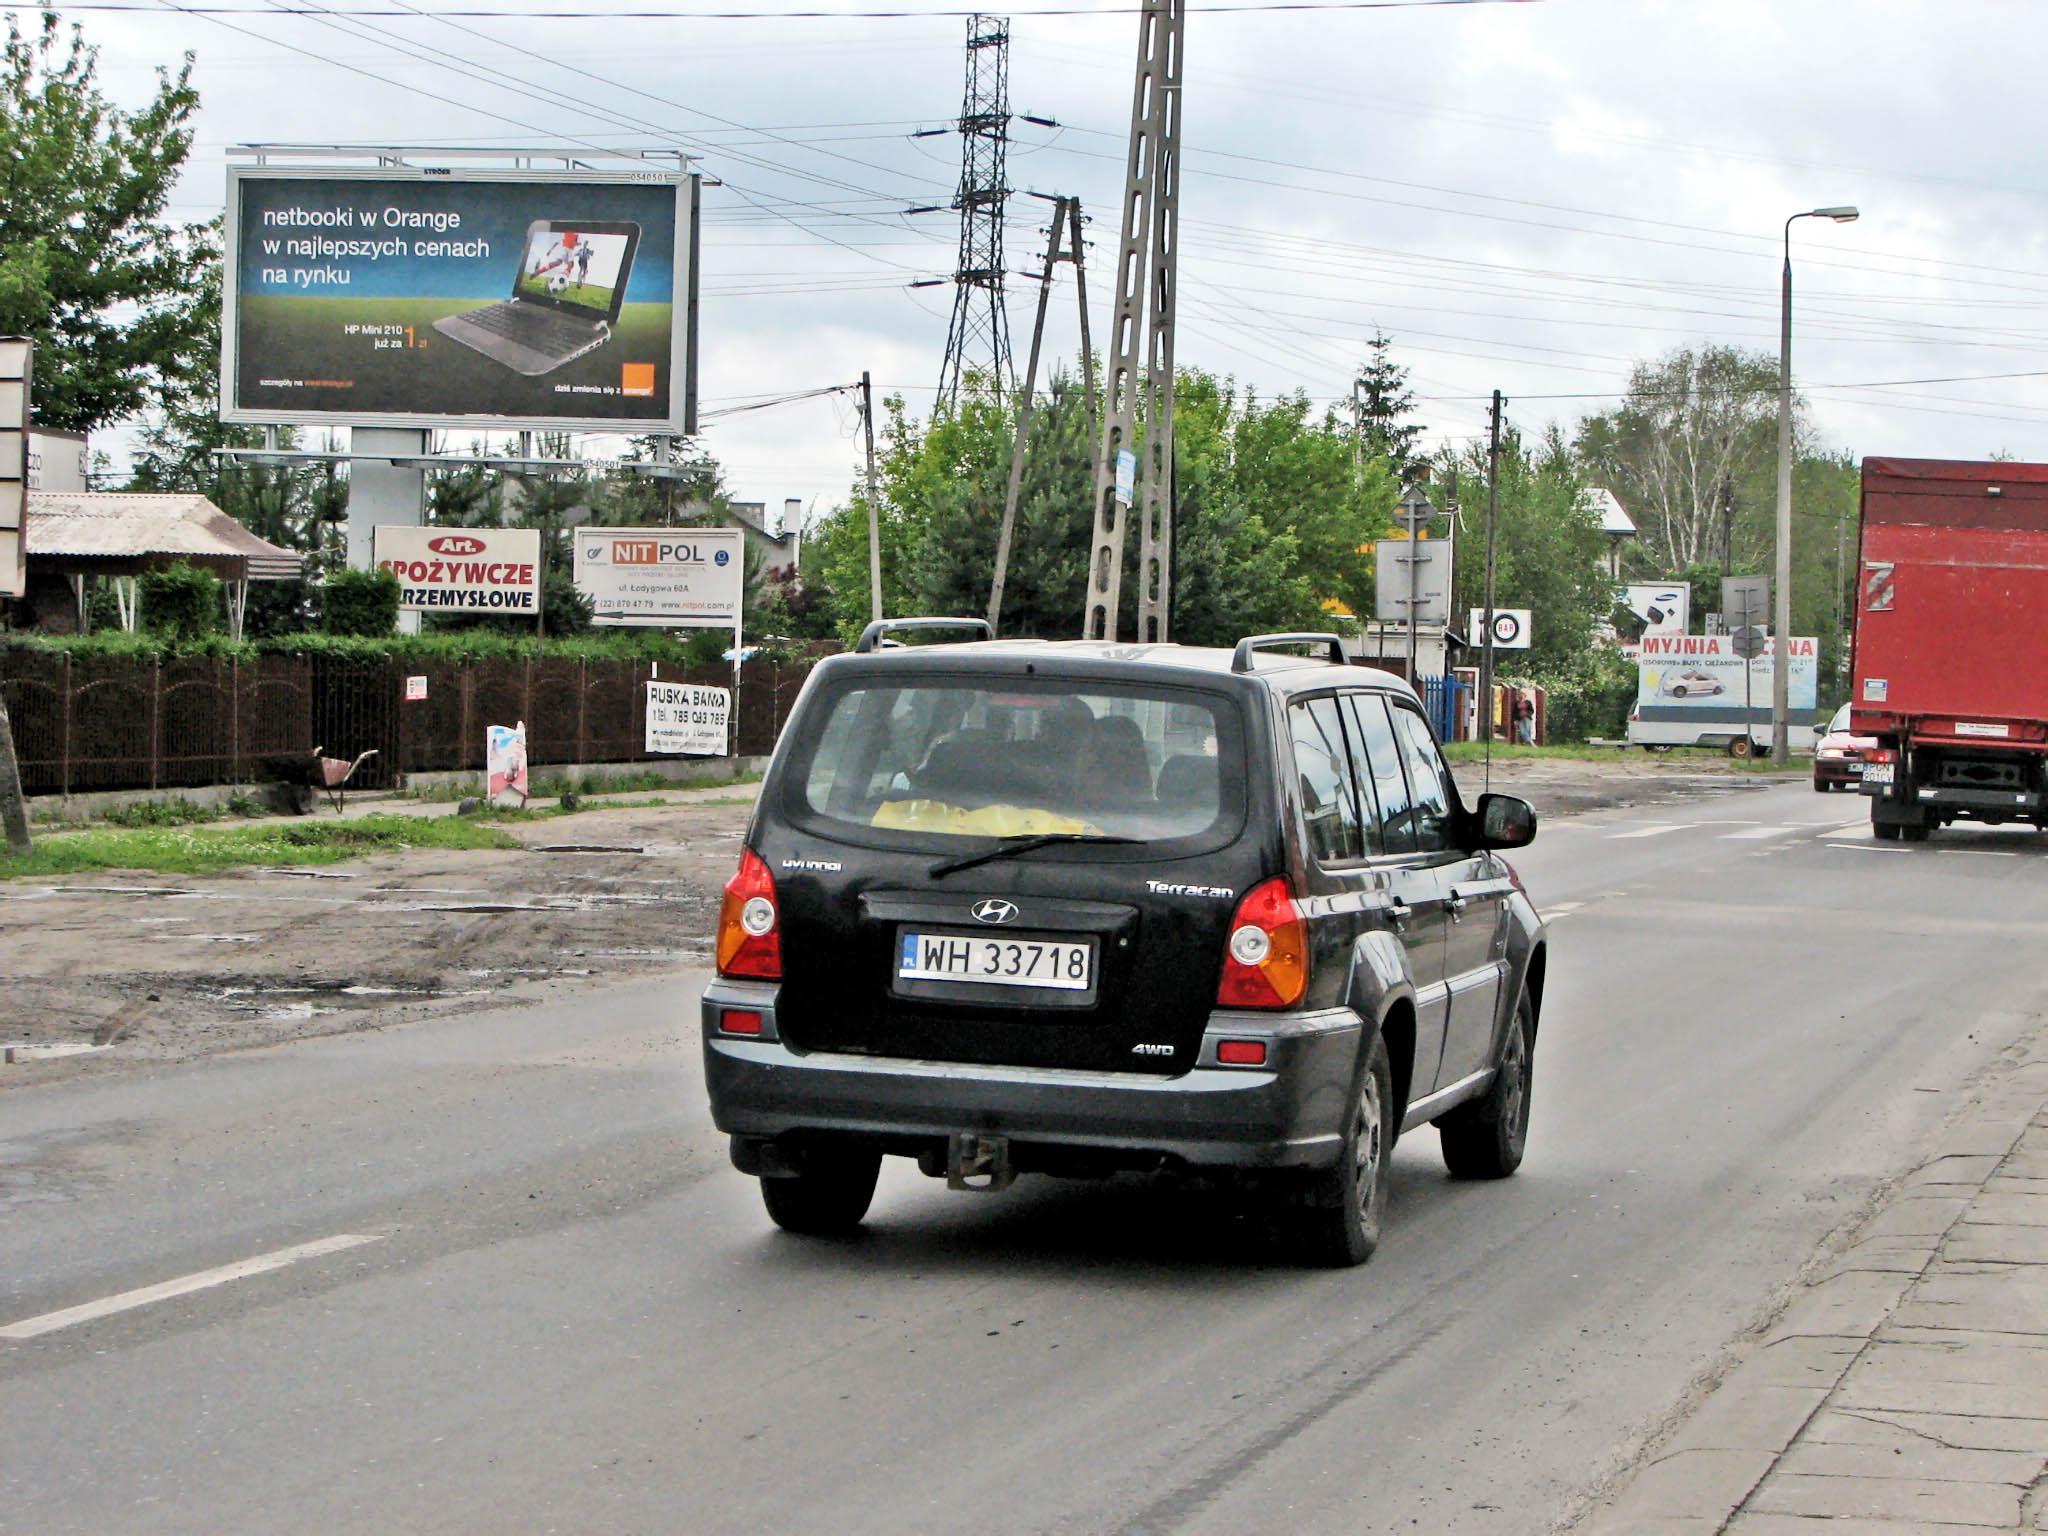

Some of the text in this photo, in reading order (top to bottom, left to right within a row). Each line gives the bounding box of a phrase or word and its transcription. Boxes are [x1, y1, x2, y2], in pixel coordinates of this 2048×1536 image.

[264, 207, 461, 232] netbooki w Orange
[263, 237, 490, 260] w najlepszych cenach
[262, 265, 350, 288] na rynku
[344, 325, 403, 335] HP Mini 210
[404, 326, 415, 348] 1
[374, 338, 389, 350] już
[439, 538, 477, 553] Art.
[380, 558, 534, 585] SPOŻYWCZE
[401, 589, 533, 608] RZEMYSŁOWE
[1498, 623, 1514, 632] BAR
[1643, 638, 1720, 655] MYJNIA
[650, 687, 690, 705] RUSKA
[710, 712, 725, 726] 785
[1146, 880, 1234, 899] Terracan
[903, 957, 915, 967] PL
[924, 939, 1084, 979] WH 33718
[1131, 1043, 1174, 1056] 4WD
